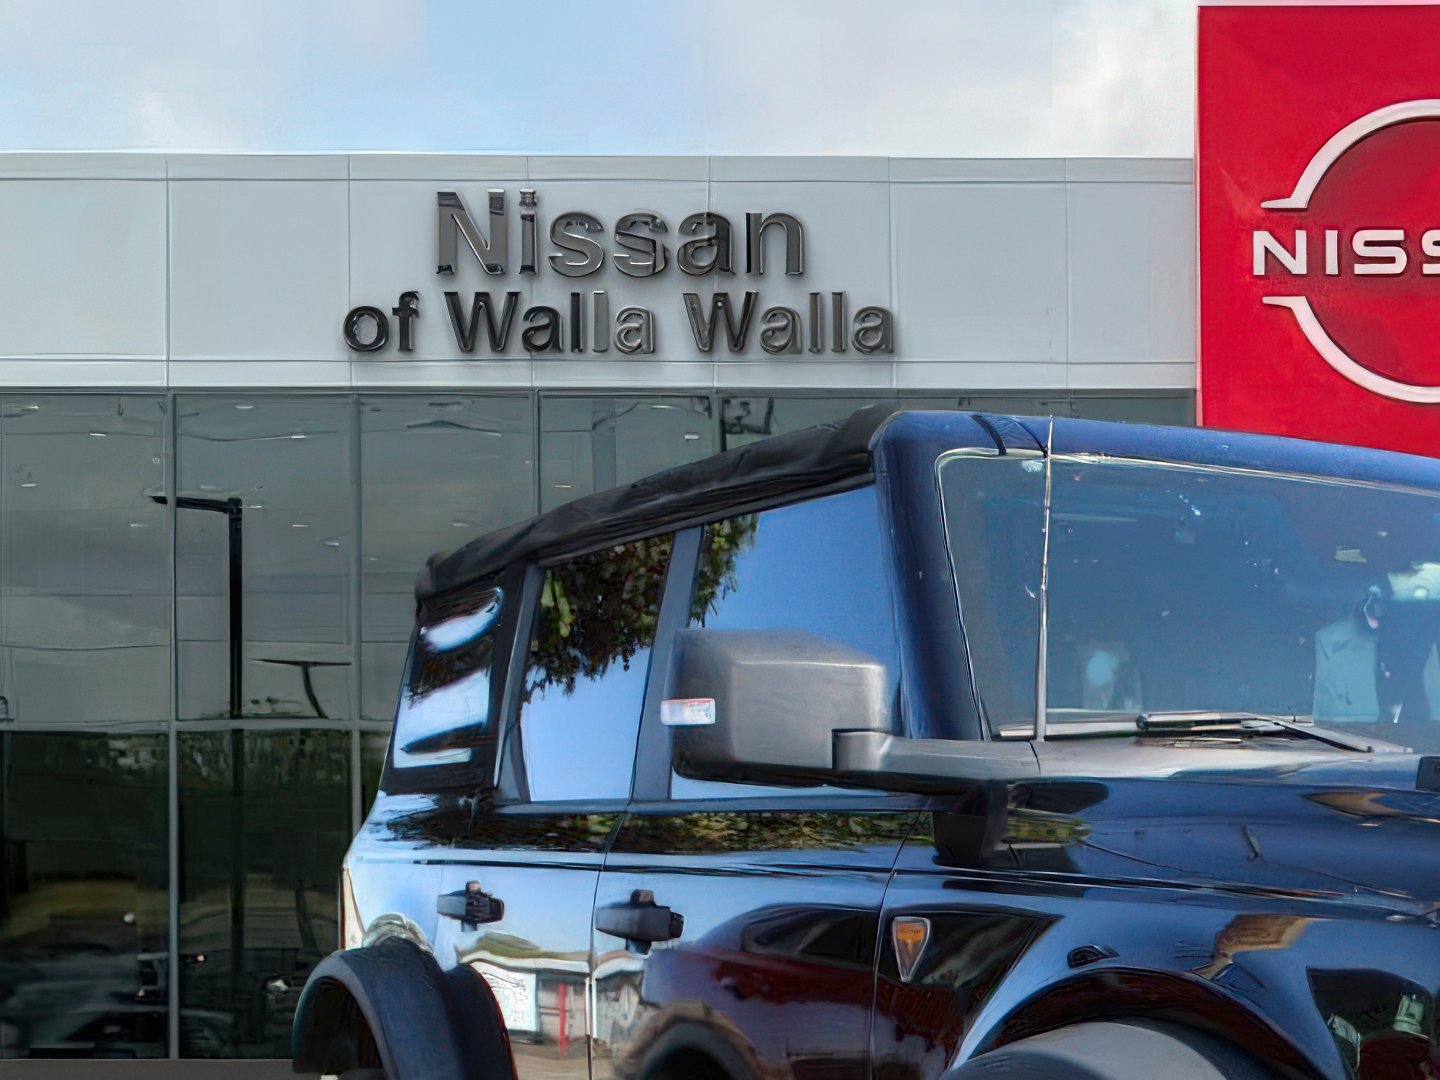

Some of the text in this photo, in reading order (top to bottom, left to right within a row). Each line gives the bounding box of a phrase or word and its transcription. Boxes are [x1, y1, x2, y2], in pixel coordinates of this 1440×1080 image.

[435, 188, 805, 278] Nissan
[342, 290, 895, 355] of Walla Walla
